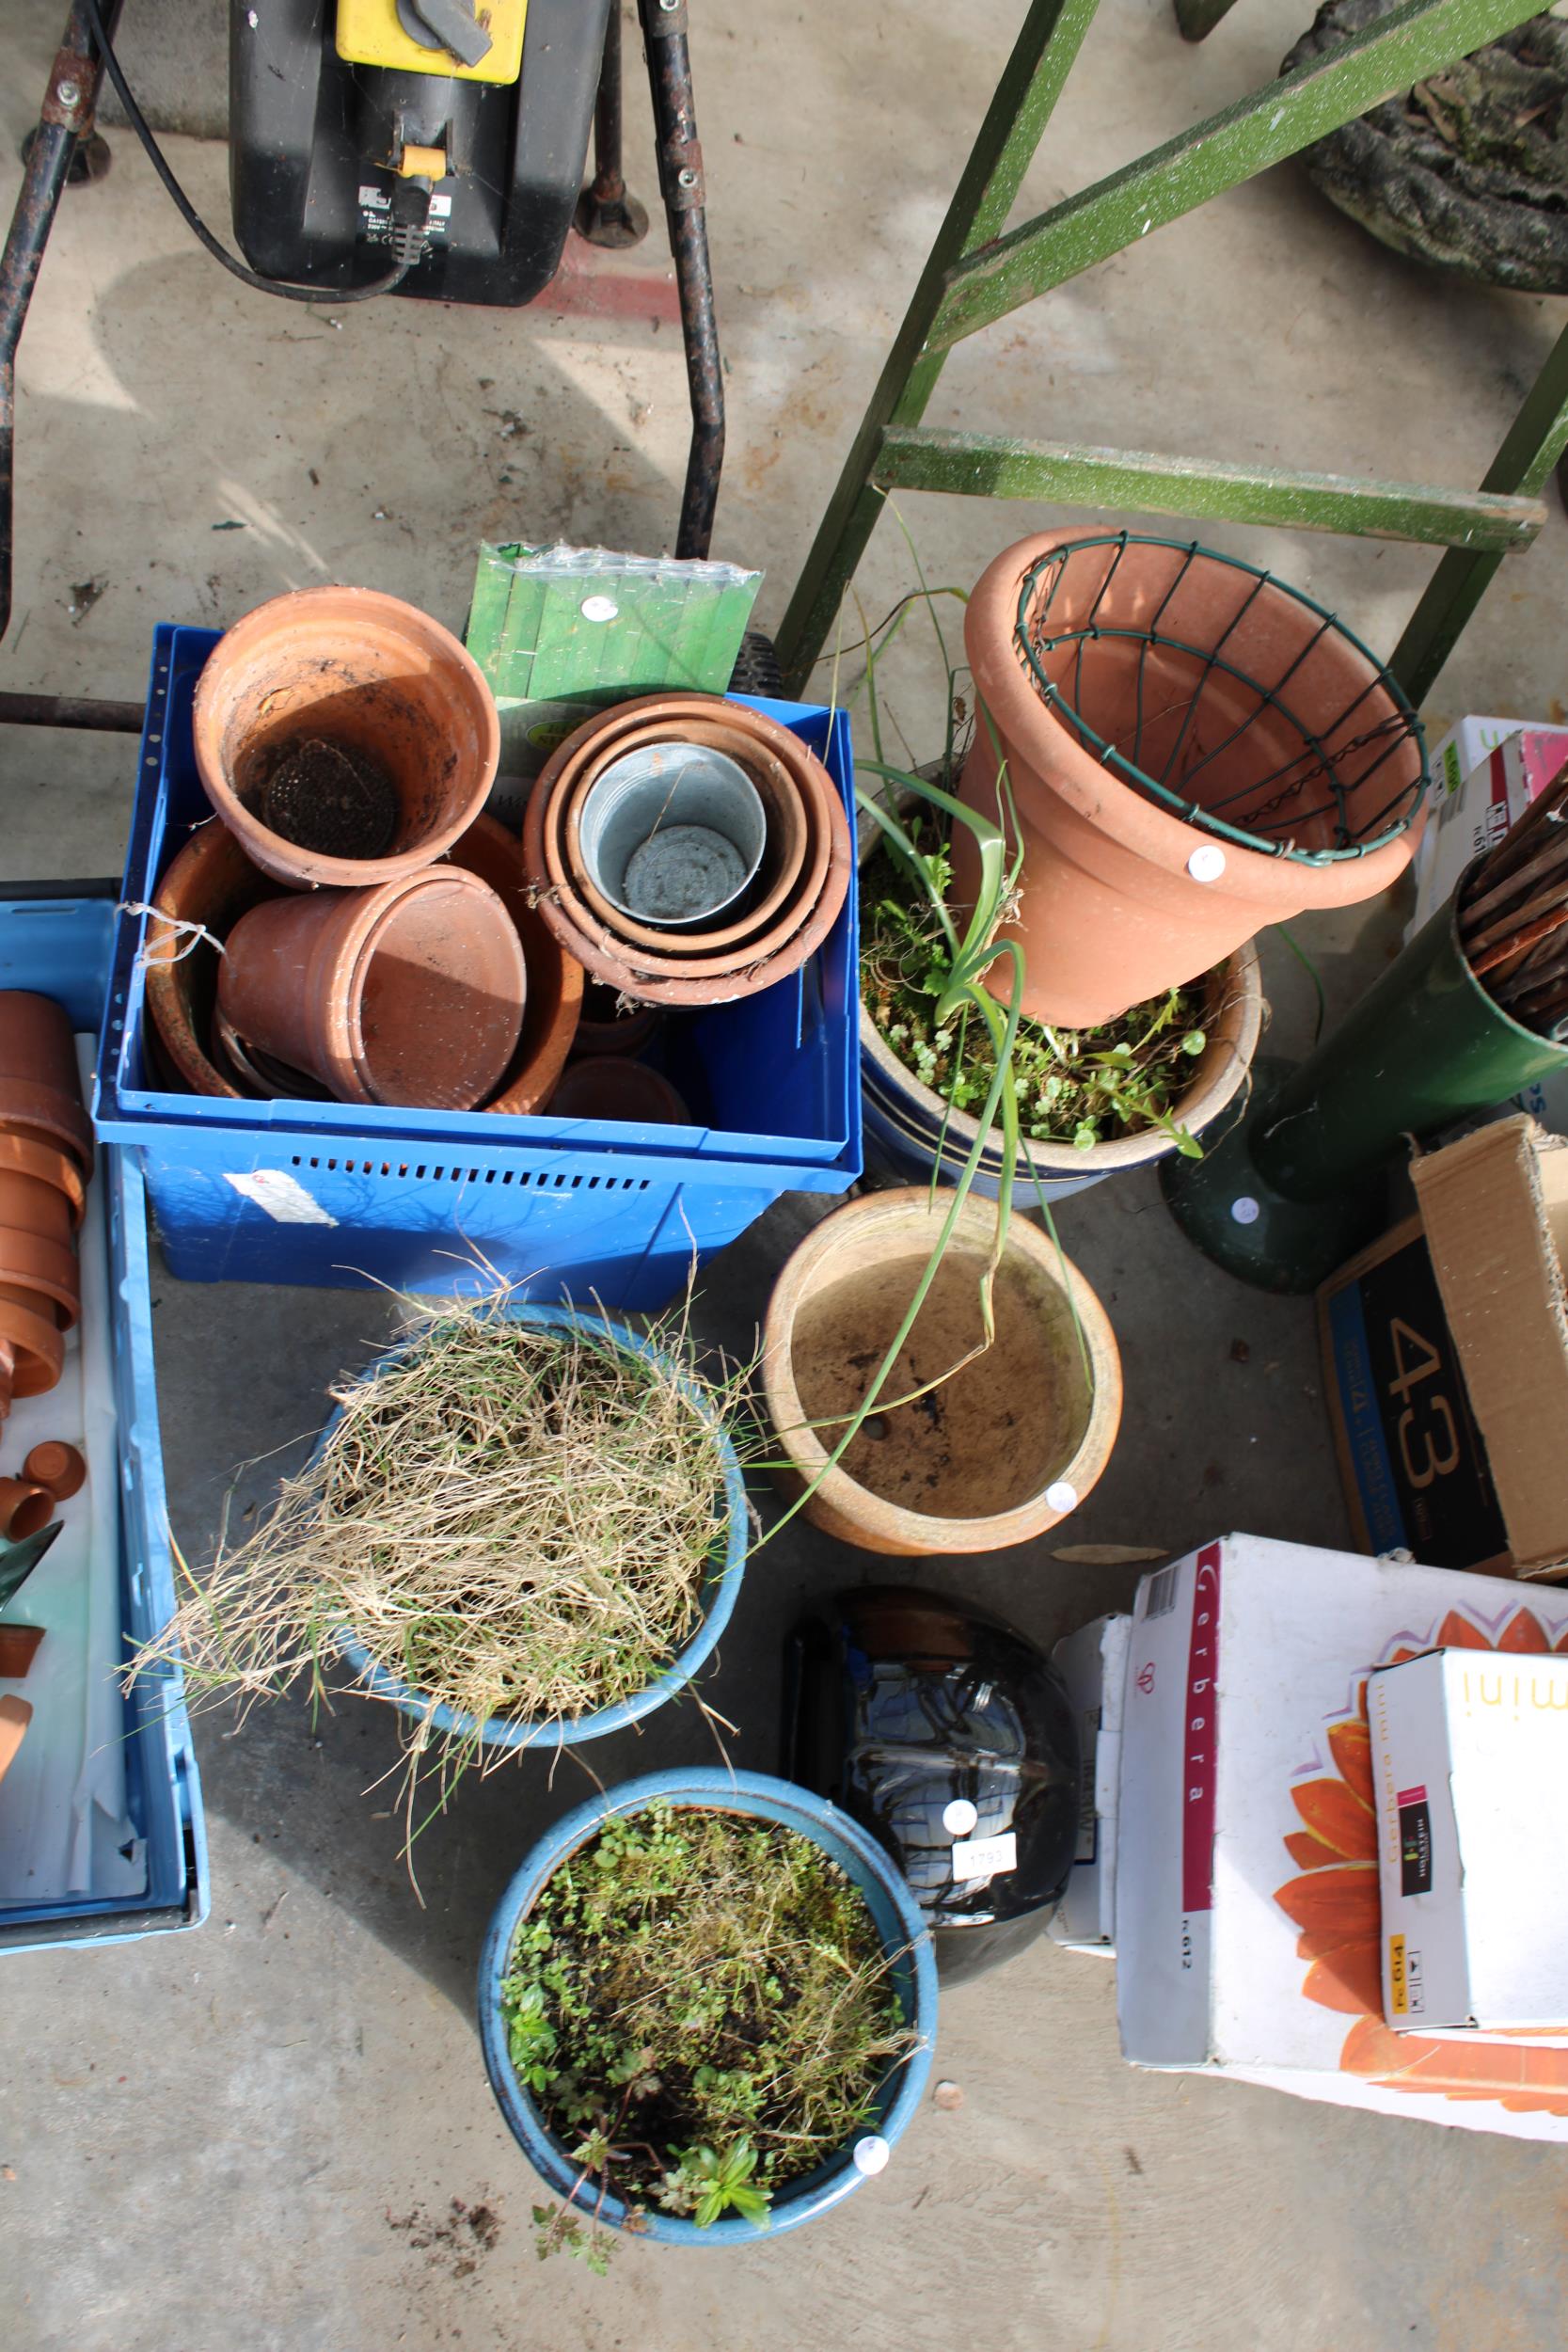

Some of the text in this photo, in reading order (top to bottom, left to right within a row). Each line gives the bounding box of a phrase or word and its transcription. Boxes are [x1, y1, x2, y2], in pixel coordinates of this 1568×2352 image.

[1388, 1317, 1459, 1488] 43
[1189, 1565, 1218, 1802] Gerbera
[1464, 1671, 1568, 1721] mini
[1375, 1684, 1398, 1863] Gerbera mini
[970, 1851, 1003, 1867] 1793
[1181, 1935, 1192, 1970] 612
[1393, 1945, 1404, 1982] 614
